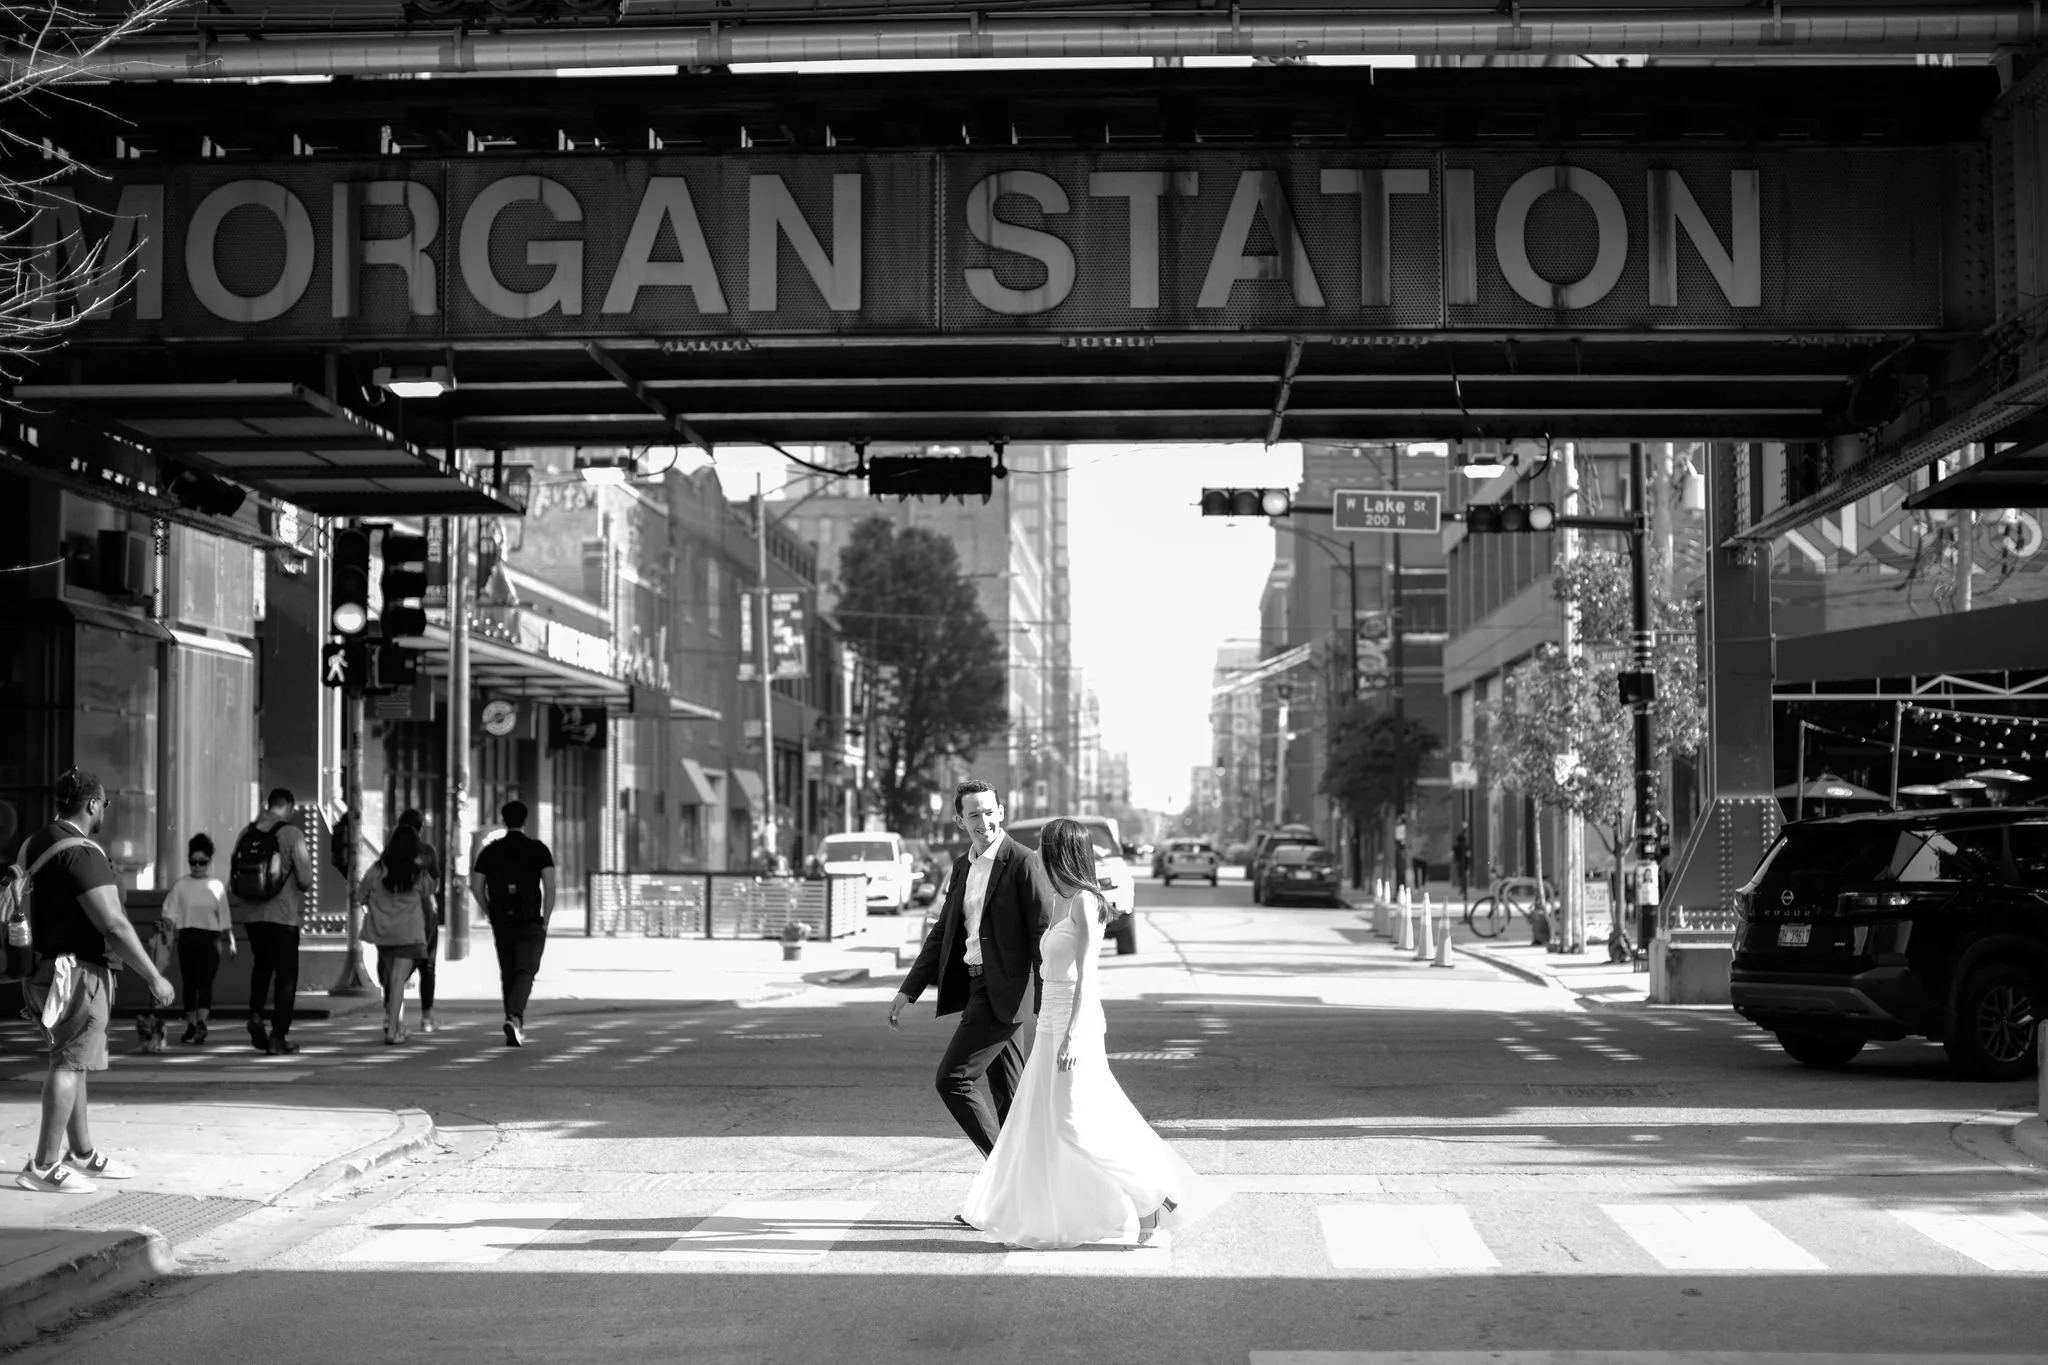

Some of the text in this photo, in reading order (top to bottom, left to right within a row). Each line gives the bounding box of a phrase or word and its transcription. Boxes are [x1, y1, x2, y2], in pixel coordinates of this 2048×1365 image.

[30, 165, 1761, 323] MORGAN STATION
[1346, 496, 1426, 514] W Lake St
[1365, 514, 1406, 527] 200 N
